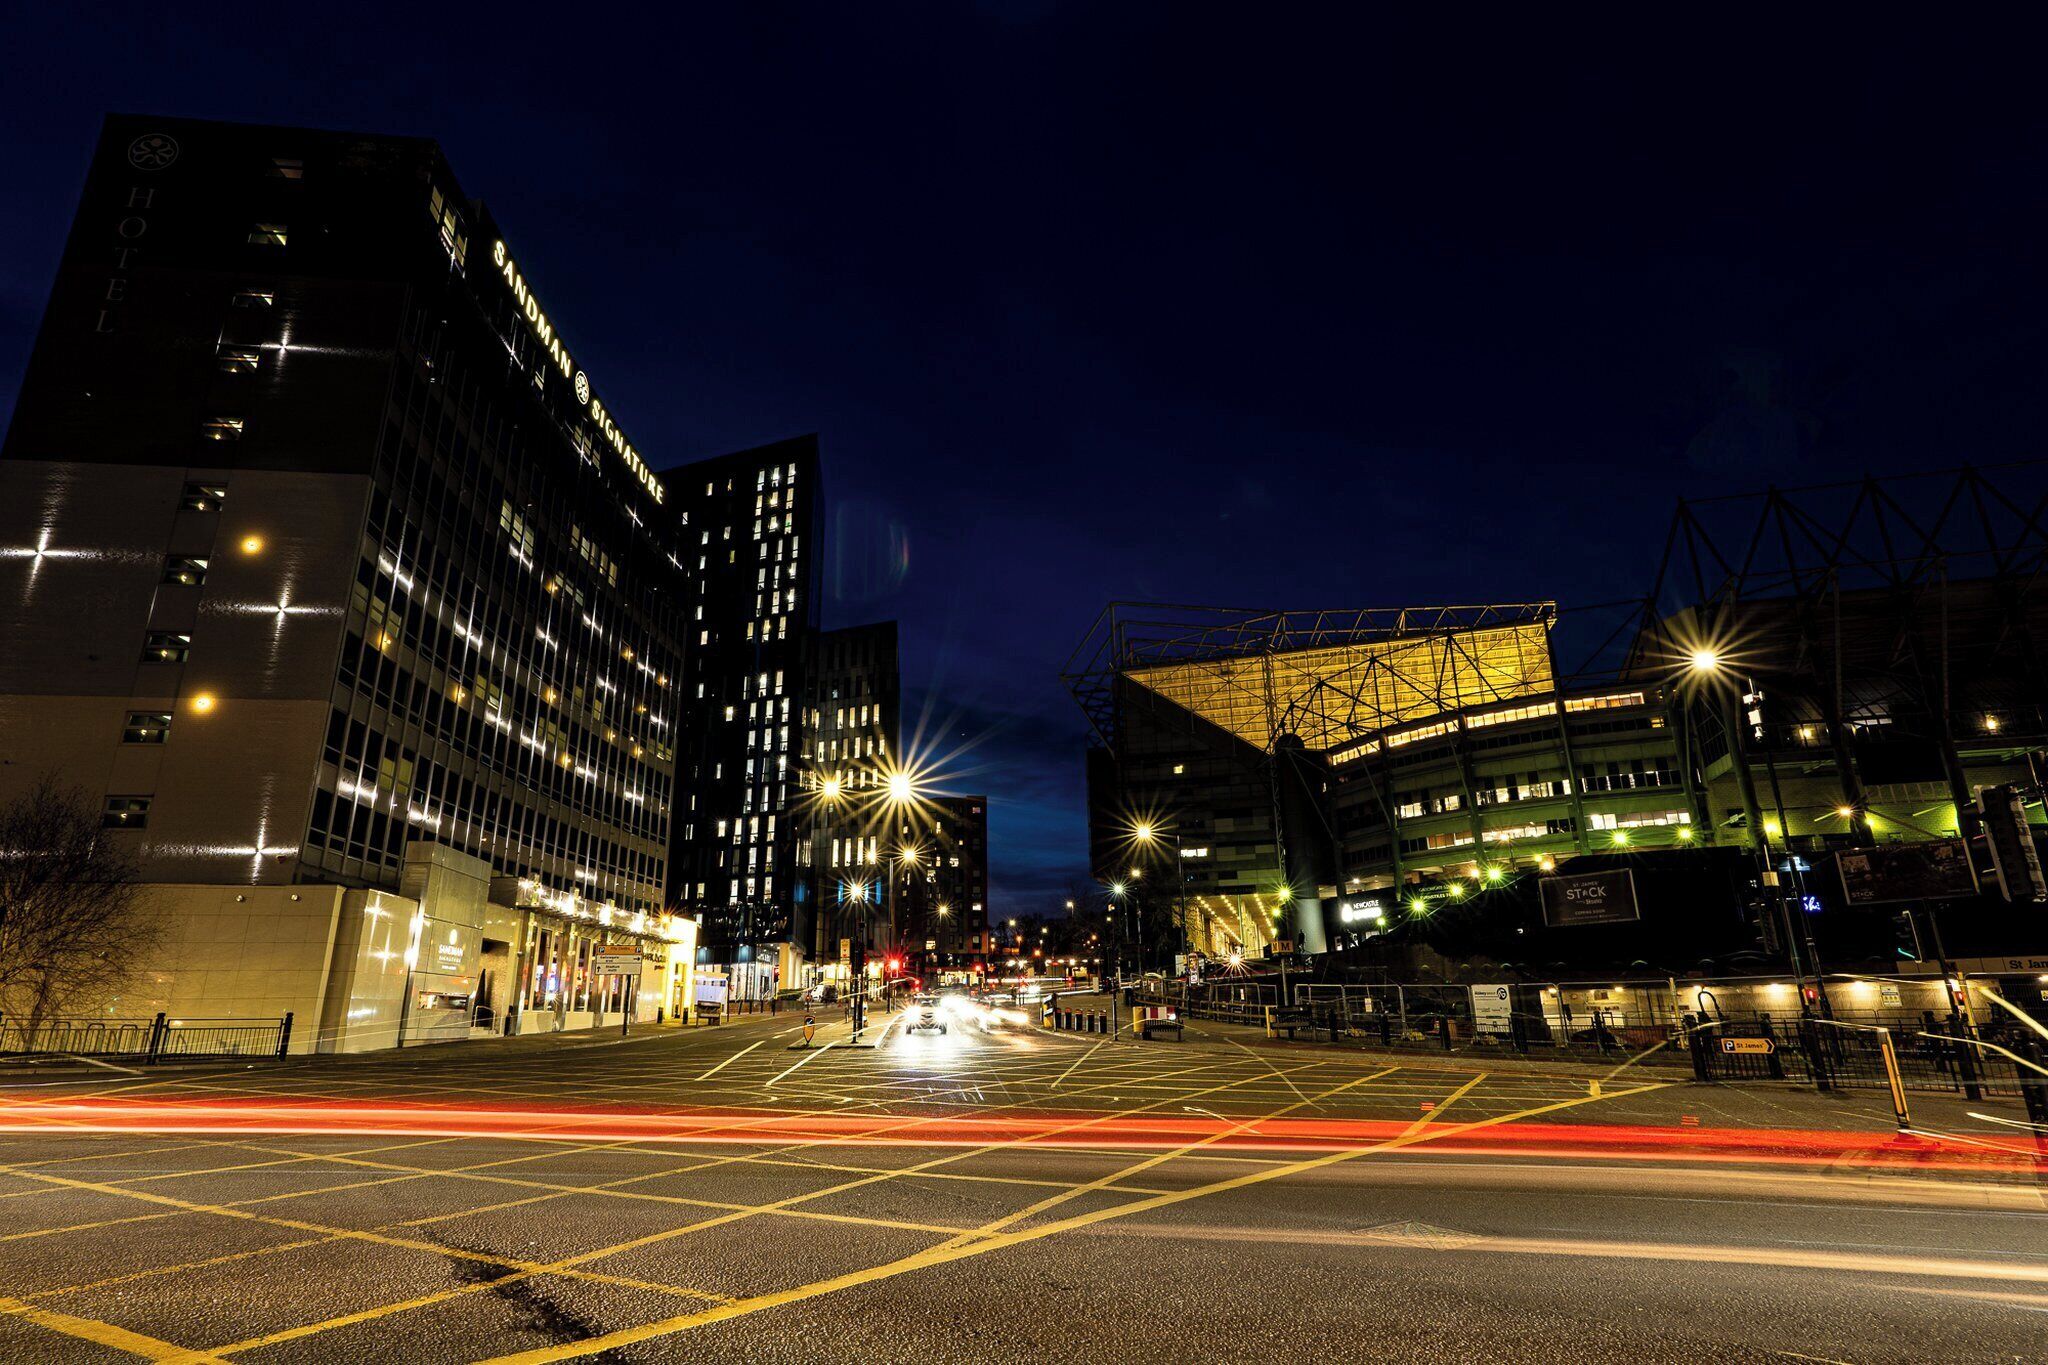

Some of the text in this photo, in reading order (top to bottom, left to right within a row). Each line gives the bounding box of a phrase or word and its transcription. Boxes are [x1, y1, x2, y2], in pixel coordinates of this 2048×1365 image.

[95, 186, 158, 333] HOTEL
[494, 240, 573, 379] SANDMAN
[591, 399, 664, 505] SIGNATURE
[1353, 899, 1380, 910] NEWCASTLE
[2009, 959, 2023, 969] St
[1726, 1041, 1734, 1050] P
